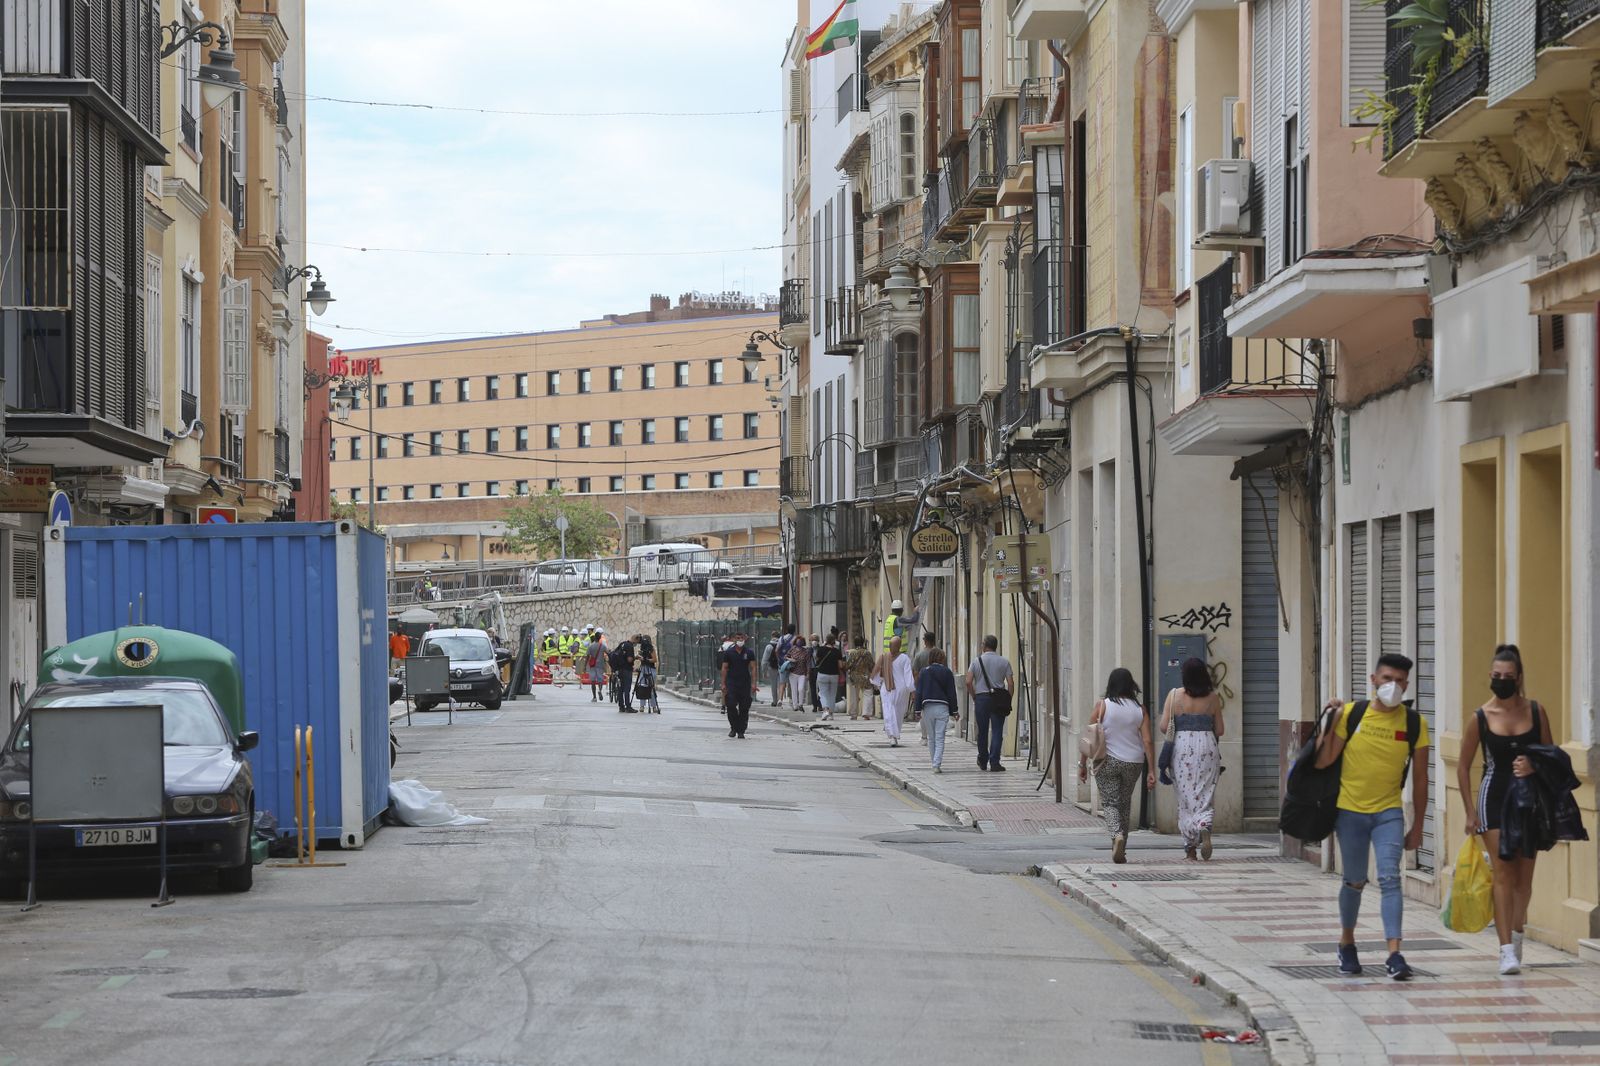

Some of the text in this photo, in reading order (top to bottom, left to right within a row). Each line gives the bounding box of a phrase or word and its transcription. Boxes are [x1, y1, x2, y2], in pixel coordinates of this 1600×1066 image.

[691, 290, 755, 304] Deutsche
[917, 533, 953, 543] Estrella
[489, 543, 511, 554] FOO
[918, 542, 951, 552] Galicia
[130, 655, 154, 668] VIDRIO
[85, 829, 152, 844] 2710 BJM
